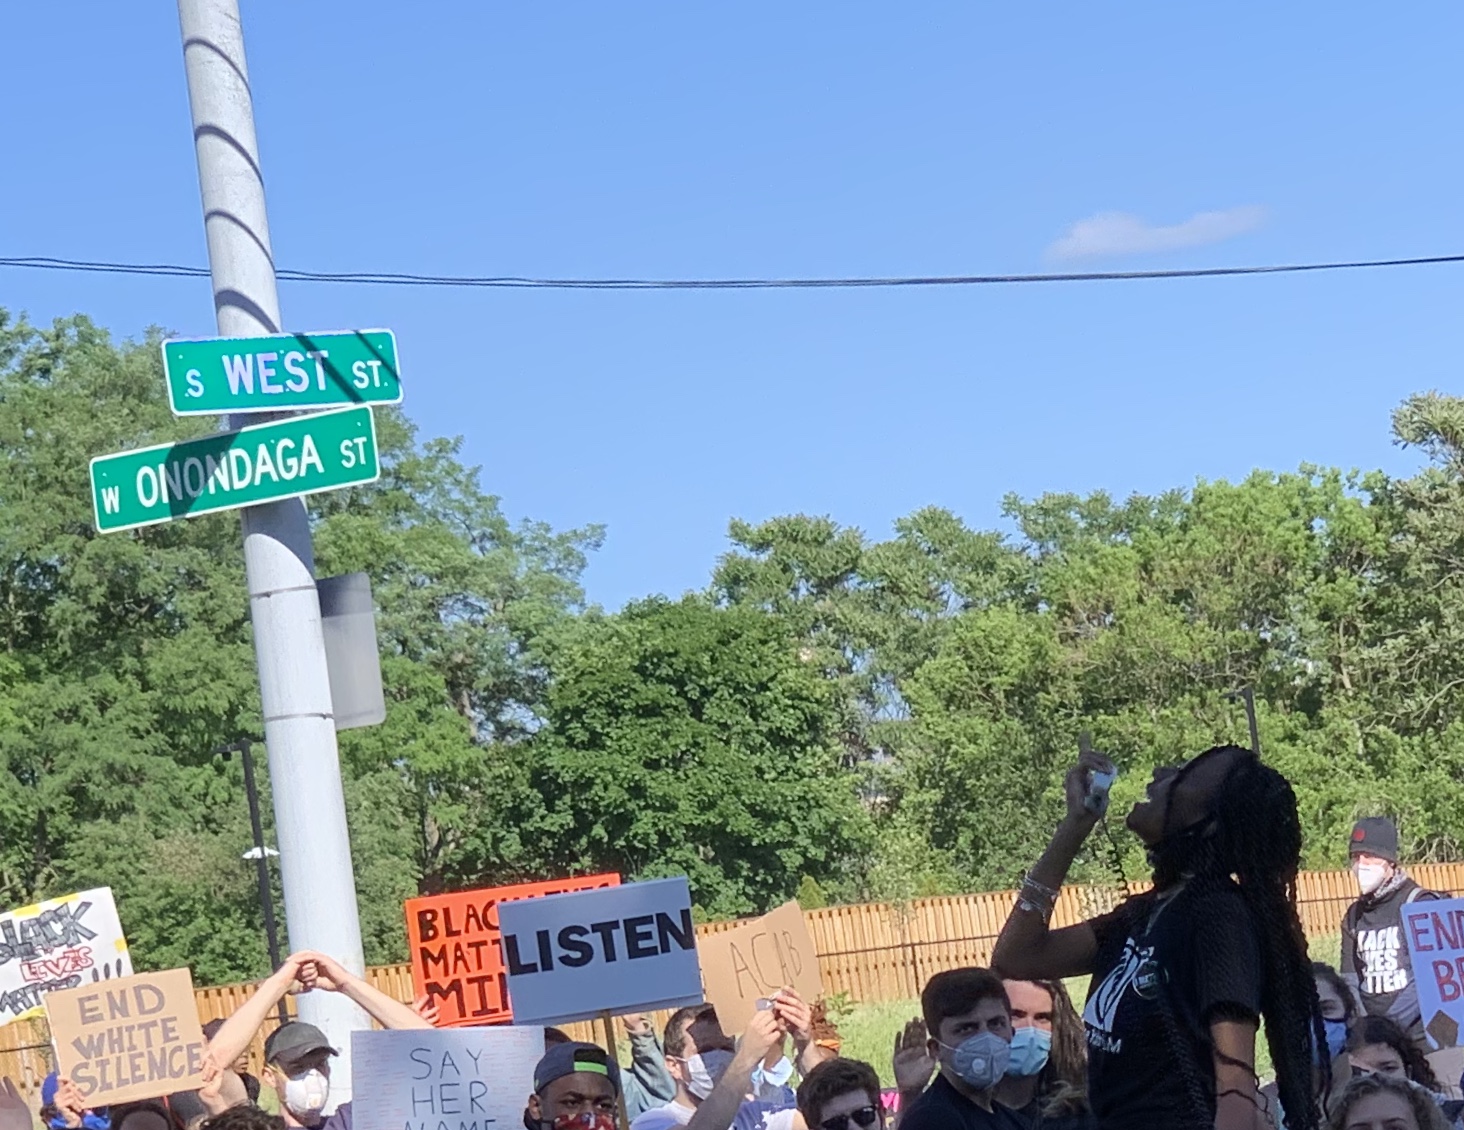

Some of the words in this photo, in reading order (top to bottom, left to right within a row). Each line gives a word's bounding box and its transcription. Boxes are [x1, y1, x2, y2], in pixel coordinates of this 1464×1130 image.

[184, 369, 205, 398] S
[222, 350, 328, 395] WEST
[101, 485, 120, 514] W
[136, 434, 324, 508] ONONDAGA
[339, 436, 368, 468] ST
[417, 898, 520, 943] BLAC
[503, 909, 695, 976] LISTEN
[20, 945, 94, 982] LIVES
[1360, 968, 1408, 994] TTER
[77, 982, 166, 1027] END
[71, 1016, 181, 1061] WHITE
[70, 1041, 203, 1097] SILENCE
[409, 1047, 483, 1081] SAY
[411, 1080, 489, 1117] HER
